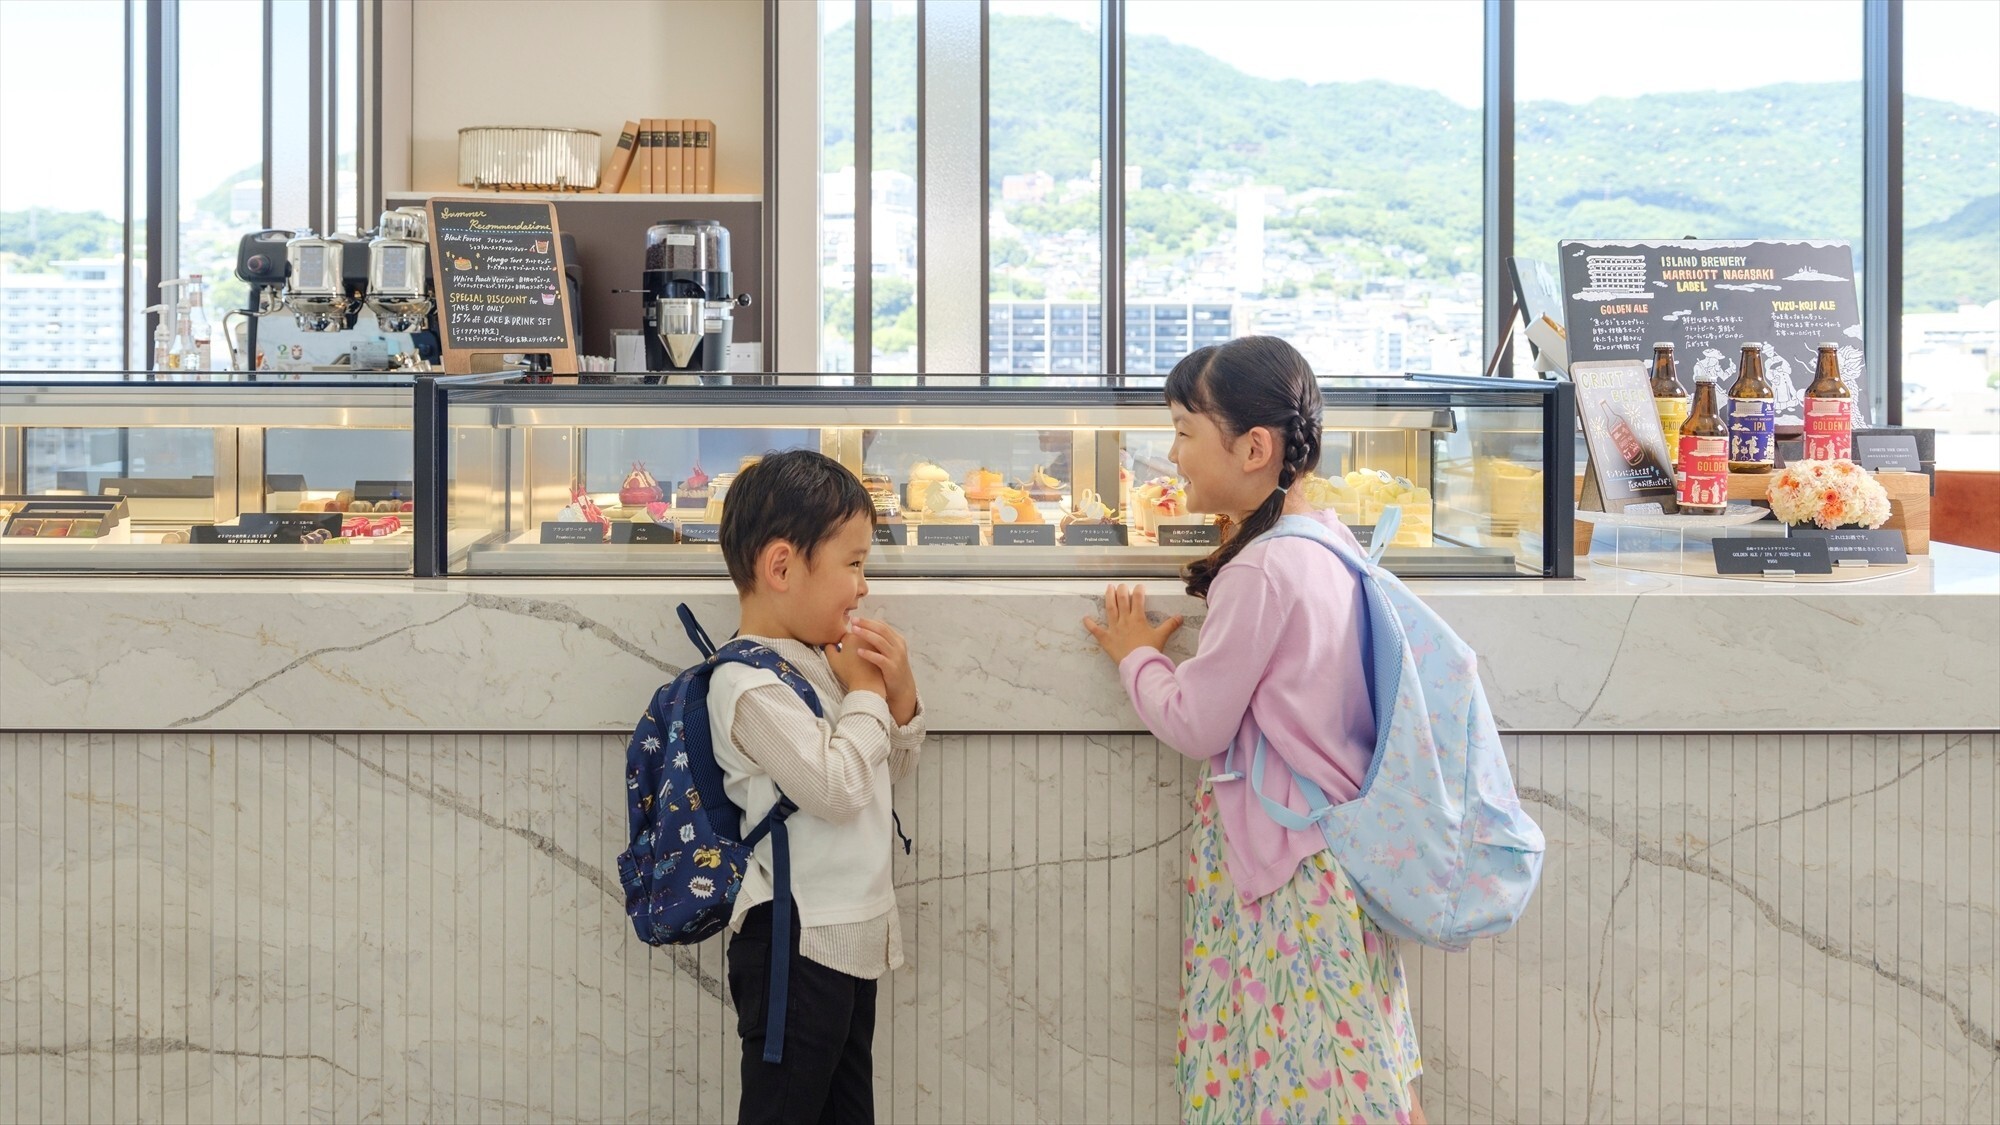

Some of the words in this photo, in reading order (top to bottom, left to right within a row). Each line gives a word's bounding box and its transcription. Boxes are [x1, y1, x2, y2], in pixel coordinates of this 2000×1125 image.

[441, 207, 487, 219] Summer
[486, 256, 509, 265] Mango
[1661, 256, 1698, 267] ISLAND
[1702, 257, 1746, 267] BREWERY
[453, 275, 473, 283] White
[1662, 269, 1718, 280] MARRIOTT
[1723, 269, 1774, 280] NAGASAKI
[1676, 281, 1708, 292] LABEL
[449, 293, 483, 303] SPECIAL
[487, 294, 528, 304] DISCOUNT
[486, 305, 504, 313] ONLY
[1600, 304, 1633, 315] GOLDEN
[1633, 304, 1649, 314] ALE
[1700, 301, 1719, 311] IPA
[1772, 300, 1817, 311] YUZU-KOJI
[1819, 301, 1836, 310] ALE
[451, 313, 471, 324] 15%
[472, 316, 481, 324] off
[537, 317, 552, 326] SET
[1581, 371, 1623, 389] CRAFT
[1611, 389, 1647, 402] BEER
[1754, 421, 1766, 431] IPA
[1812, 421, 1843, 431] GOLDEN
